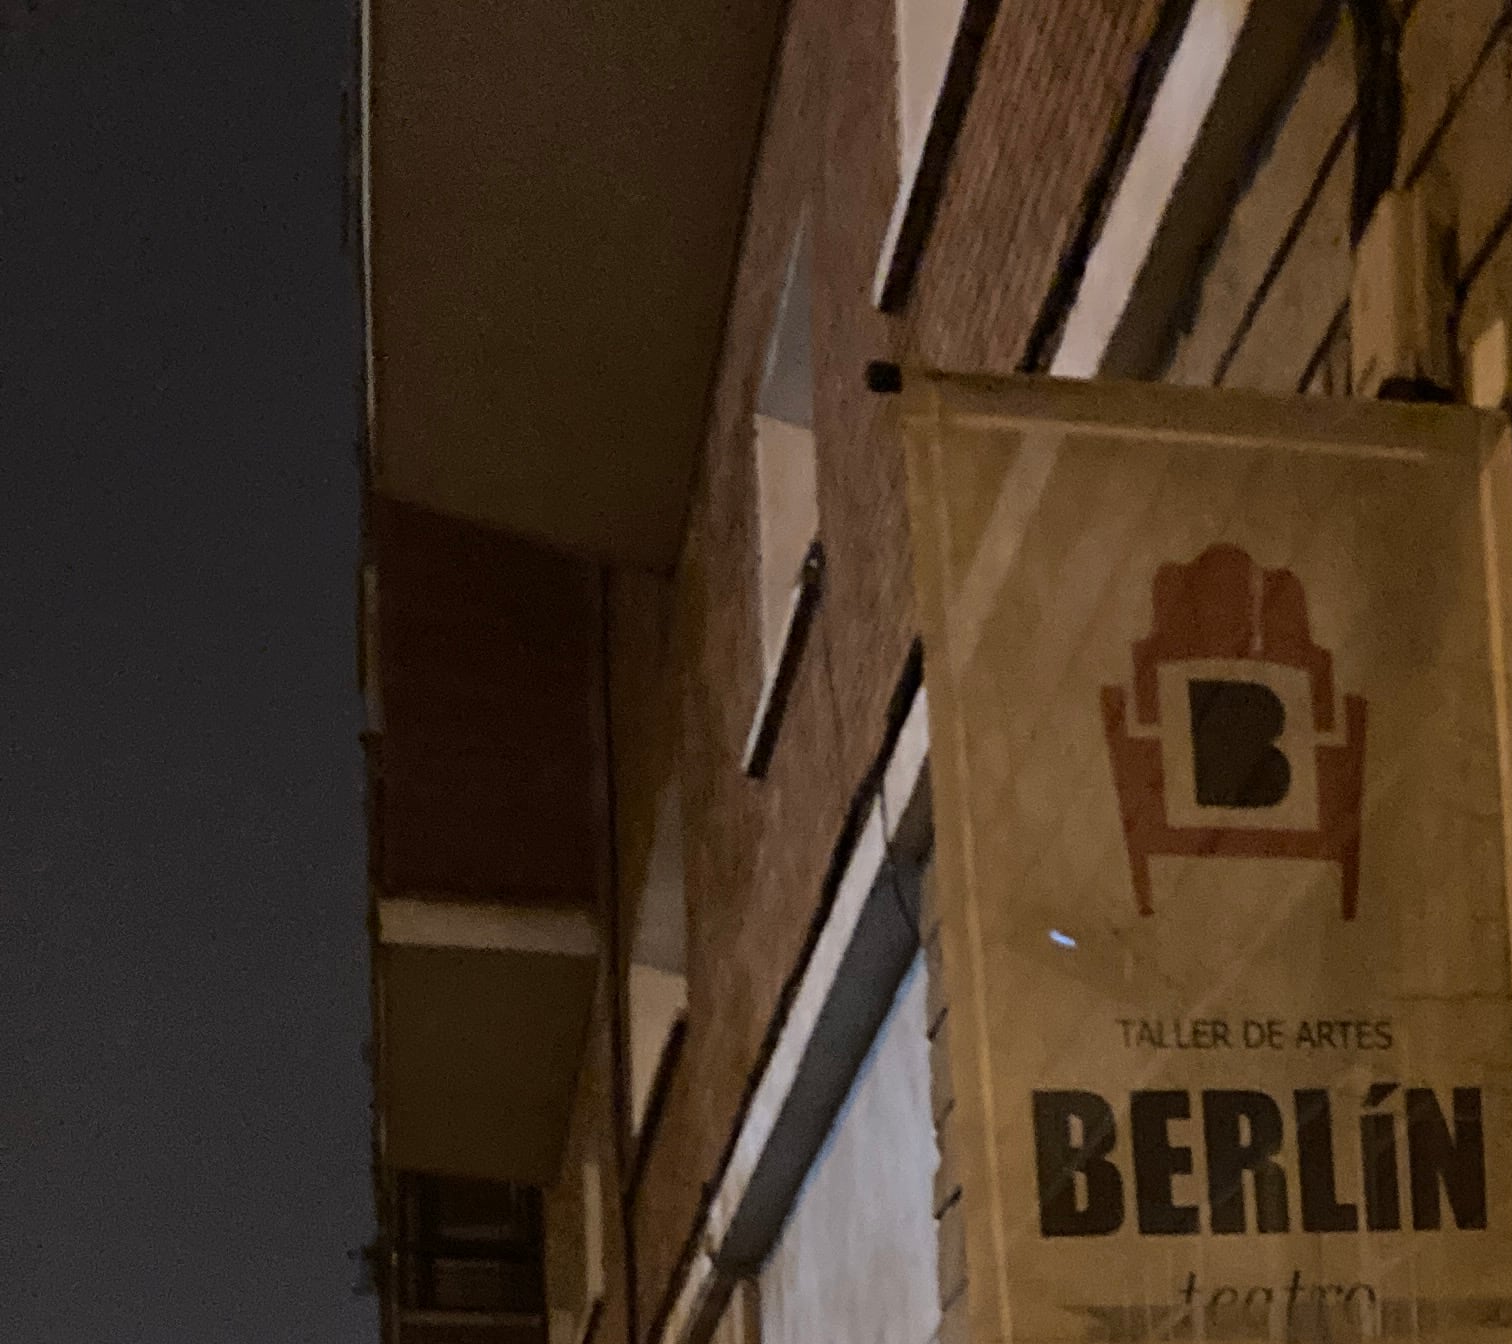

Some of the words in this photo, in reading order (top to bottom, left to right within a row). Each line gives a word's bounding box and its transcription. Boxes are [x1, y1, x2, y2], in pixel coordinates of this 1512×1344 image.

[1188, 677, 1292, 809] B
[1117, 1018, 1231, 1050] TALLER
[1242, 1018, 1285, 1050] DE
[1294, 1018, 1394, 1051] ARTES
